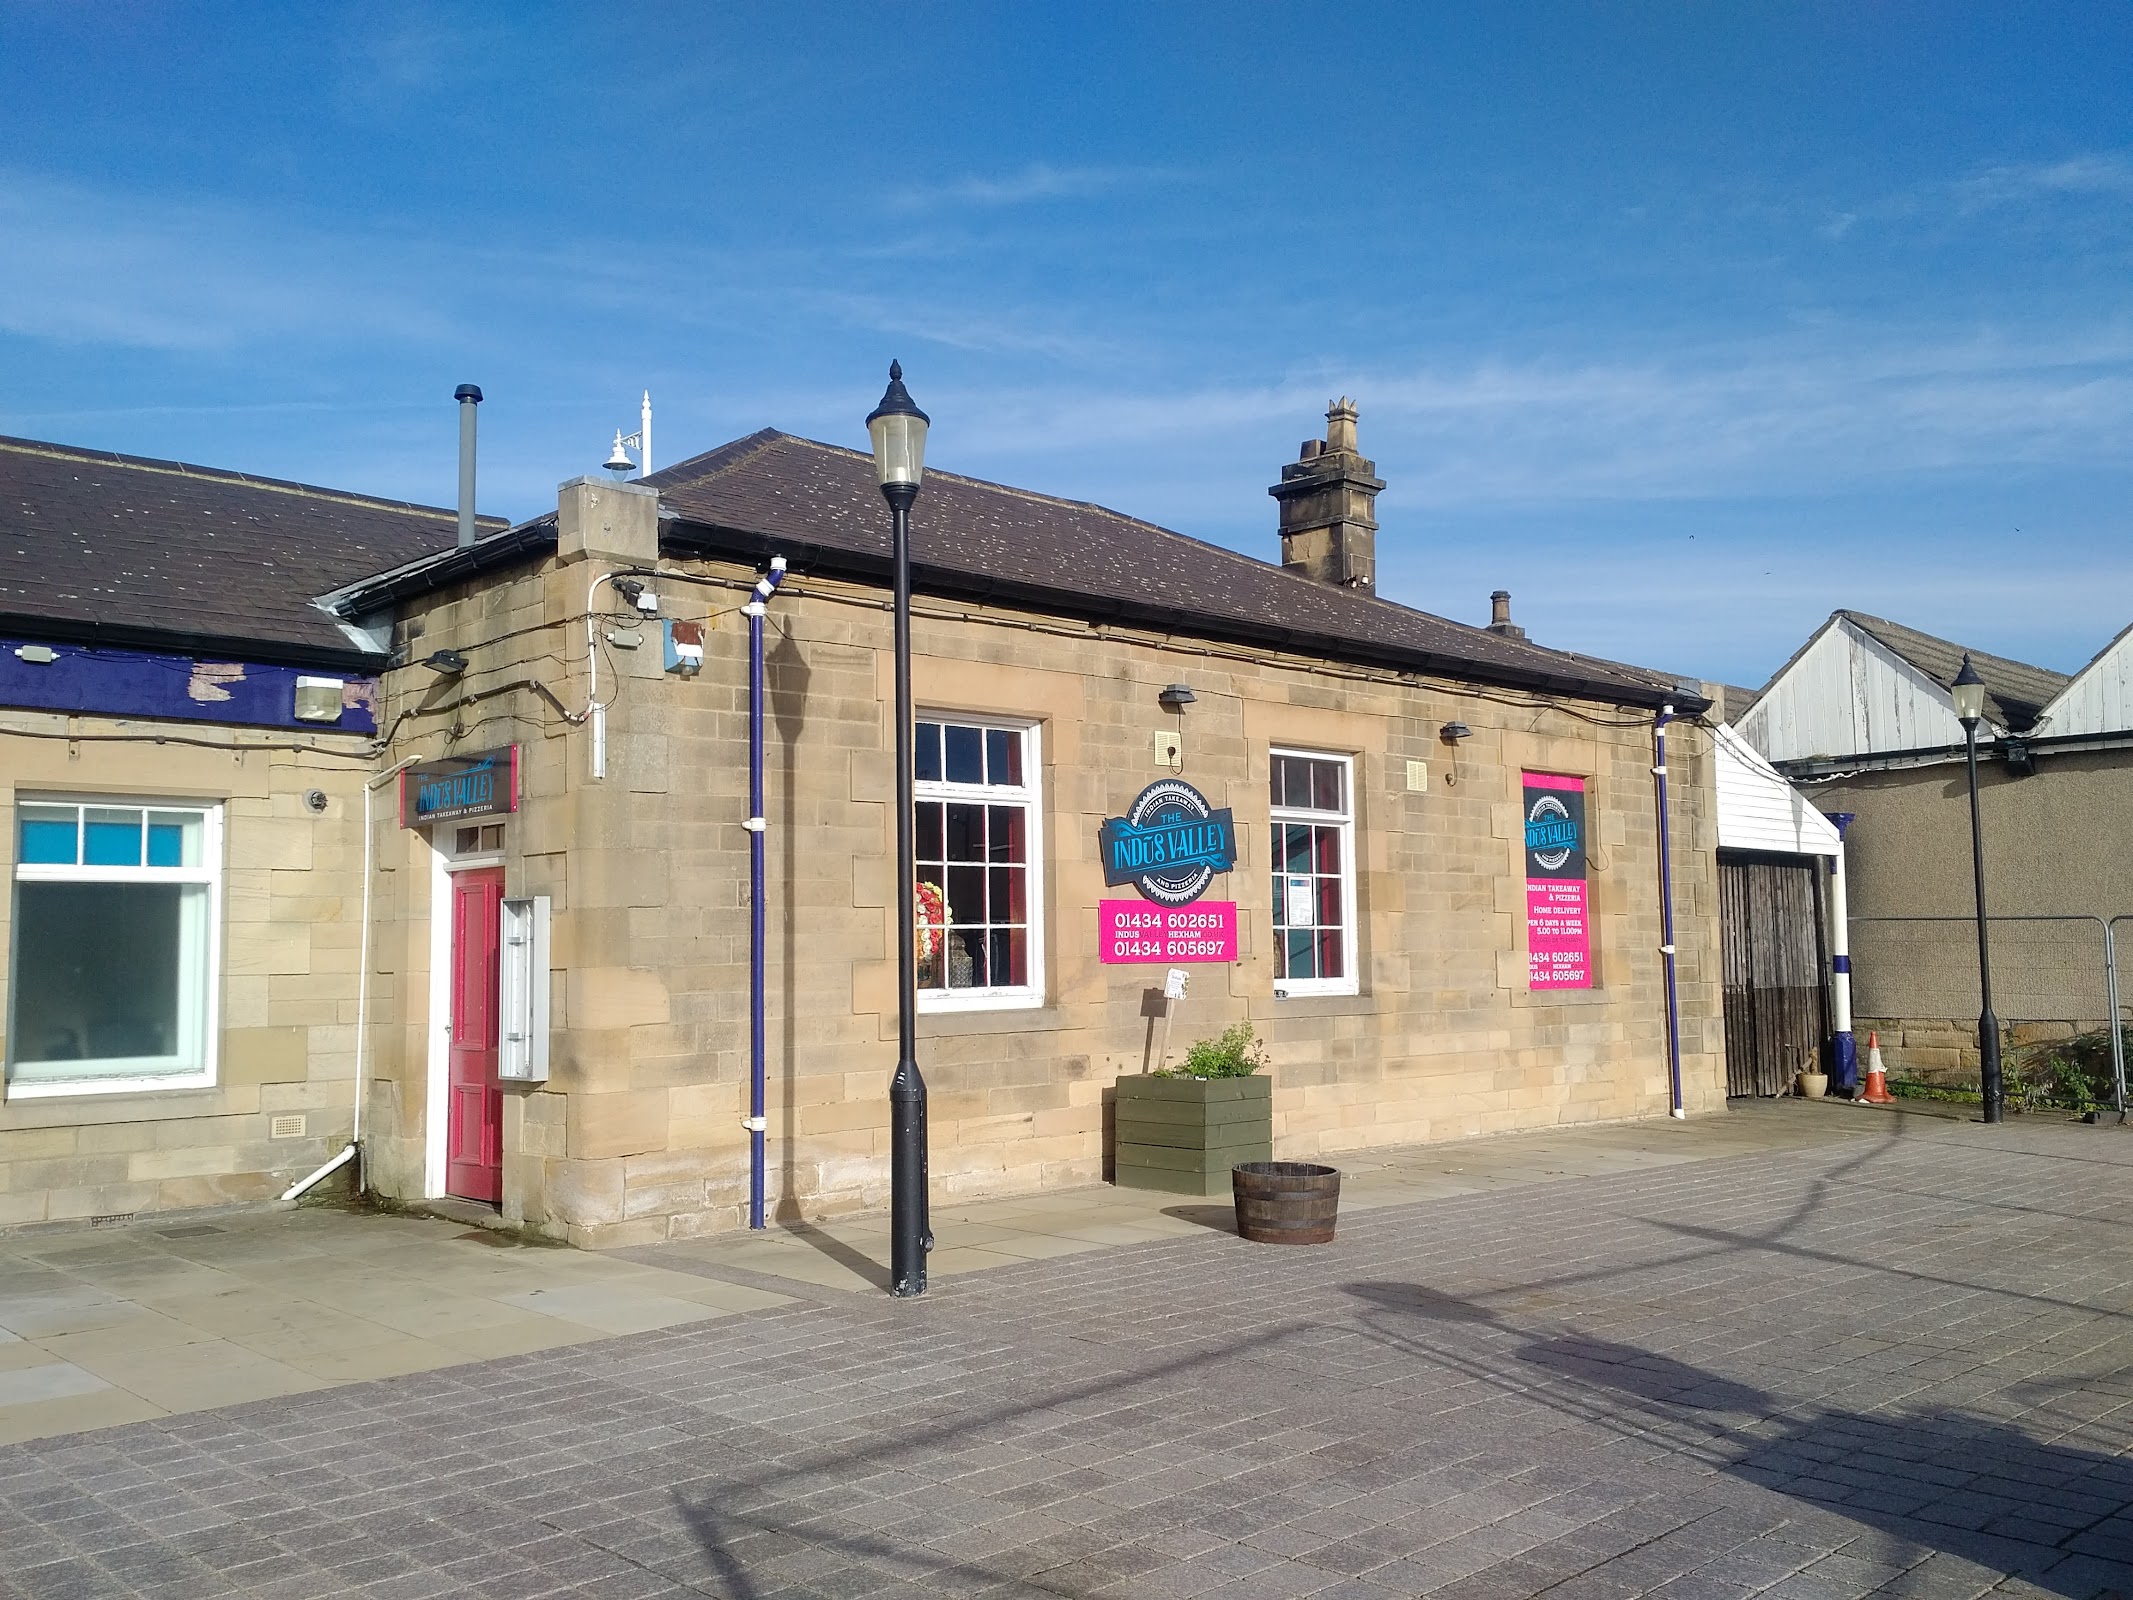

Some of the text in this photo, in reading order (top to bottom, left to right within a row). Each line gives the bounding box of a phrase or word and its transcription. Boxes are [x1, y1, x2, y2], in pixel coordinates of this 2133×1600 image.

[417, 774, 429, 782] THE
[453, 772, 495, 807] VALLEY
[418, 813, 436, 822] INDIAN
[437, 809, 462, 819] TAKEAWAY
[468, 804, 493, 813] PIZZERIA
[1144, 795, 1195, 818] INDIAN TAKEAWAY
[1161, 812, 1182, 824] THE
[1543, 813, 1555, 821] THE
[1547, 821, 1577, 844] VALLEY
[1167, 823, 1227, 860] VALLEY
[1156, 872, 1199, 889] AND PIZZERIA
[1547, 885, 1580, 893] TAKEAWAY
[1548, 893, 1581, 902] & PIZZERIA
[1114, 913, 1224, 929] 01434 602651
[1539, 918, 1544, 926] 6
[1114, 941, 1225, 956] 01434 605697
[1552, 952, 1584, 962] 602651
[1552, 970, 1585, 980] 605697
